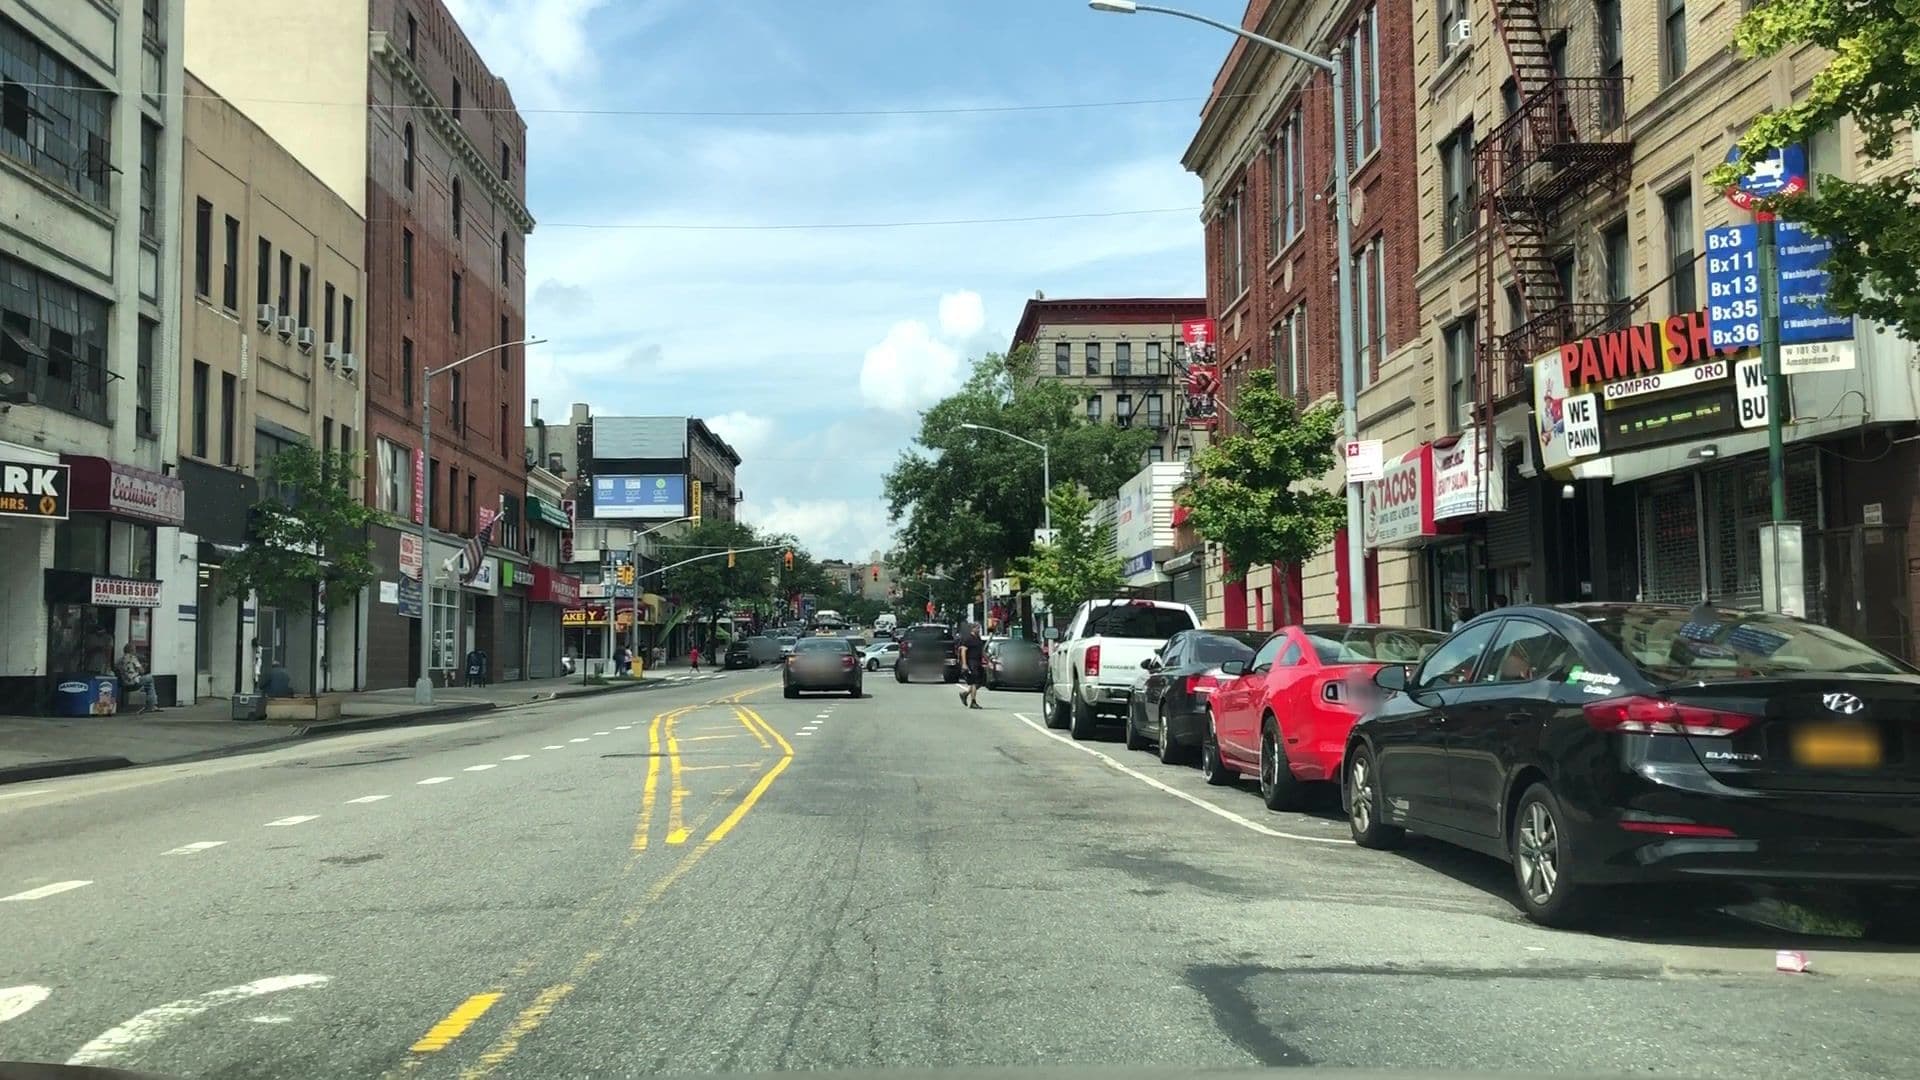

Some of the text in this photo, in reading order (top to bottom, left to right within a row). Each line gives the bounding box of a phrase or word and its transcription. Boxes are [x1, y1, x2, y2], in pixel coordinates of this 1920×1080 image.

[1709, 229, 1742, 249] Bx3
[1710, 251, 1753, 273] Bx11
[1711, 275, 1757, 297] Bx13
[1712, 299, 1758, 321] Bx35
[1713, 323, 1759, 345] Bx36
[1790, 318, 1828, 329] Washington
[1560, 323, 1656, 388] PAWN
[1607, 363, 1724, 397] COMPRO ORO
[1568, 400, 1590, 424] WE
[1743, 395, 1768, 421] BU
[1567, 427, 1598, 450] PAWN
[0, 465, 59, 497] RK
[112, 475, 158, 508] Exclusive
[1378, 466, 1417, 511] TACOS
[96, 583, 159, 597] BARBERSHOP
[1705, 751, 1762, 761] ELANTRA
